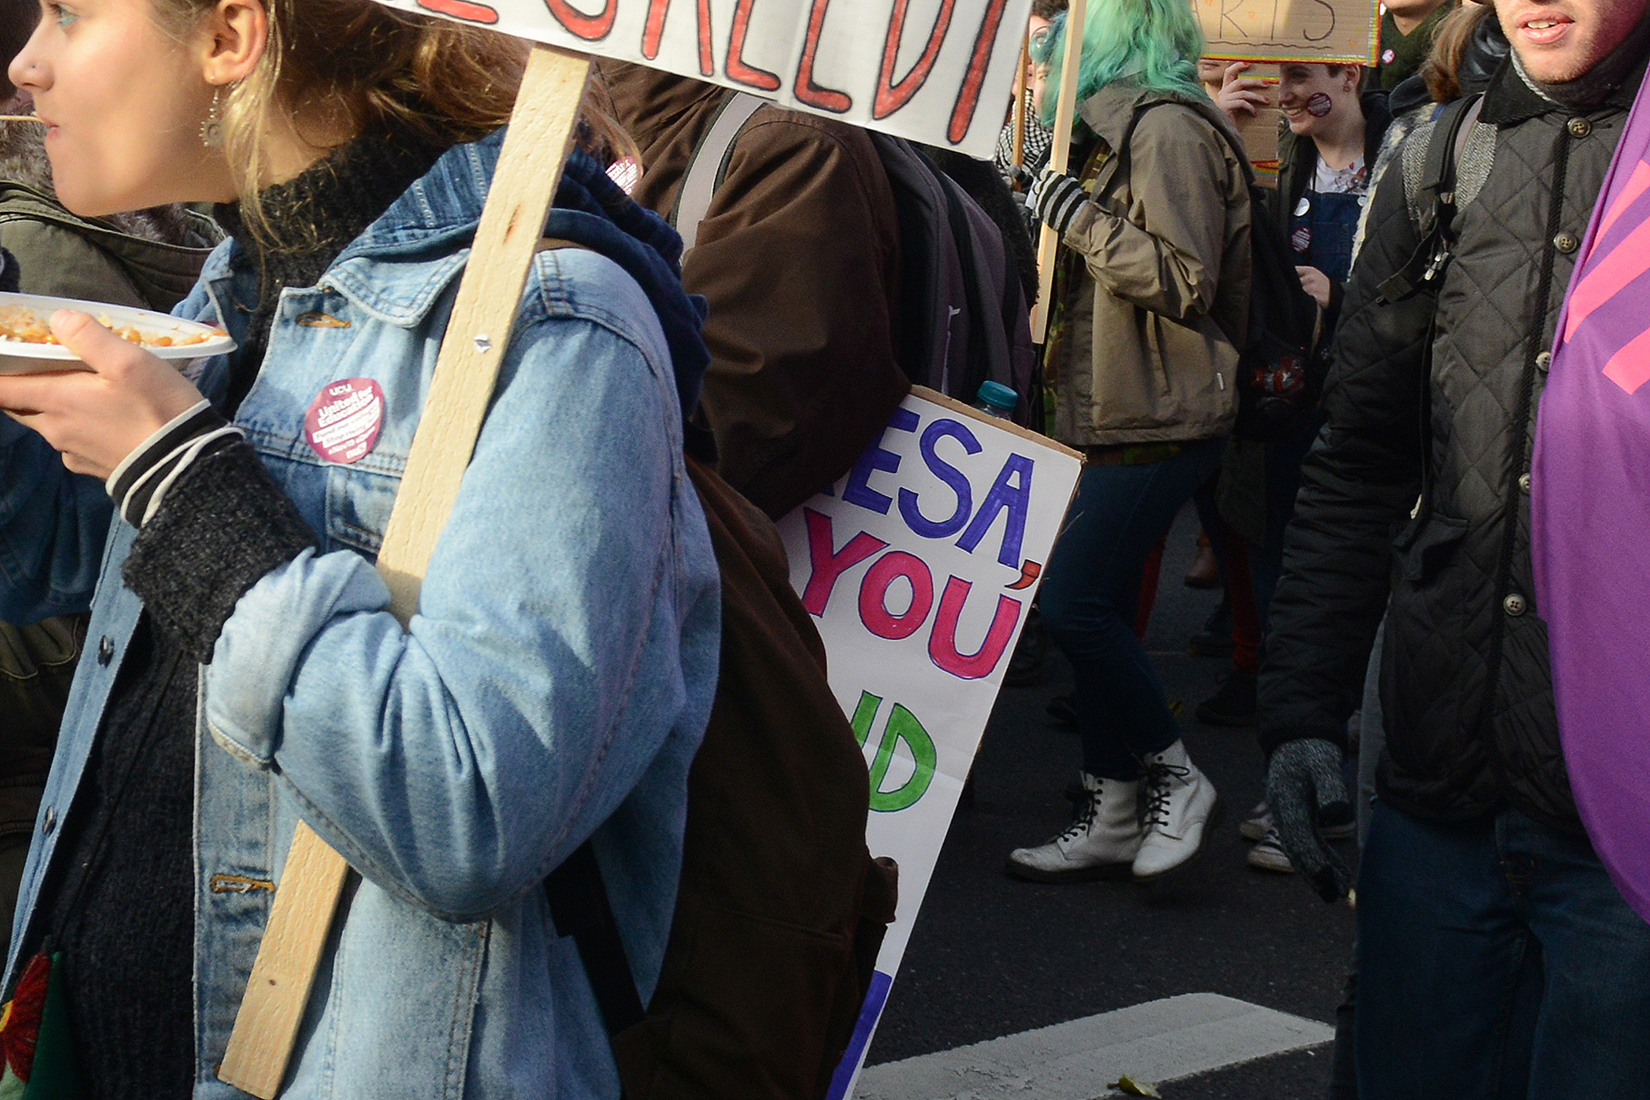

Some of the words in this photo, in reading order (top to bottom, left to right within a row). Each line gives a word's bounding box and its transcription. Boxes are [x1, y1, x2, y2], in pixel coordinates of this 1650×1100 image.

[317, 391, 358, 418] United
[358, 385, 373, 401] for
[317, 393, 374, 428] Education
[802, 506, 1022, 680] YOU
